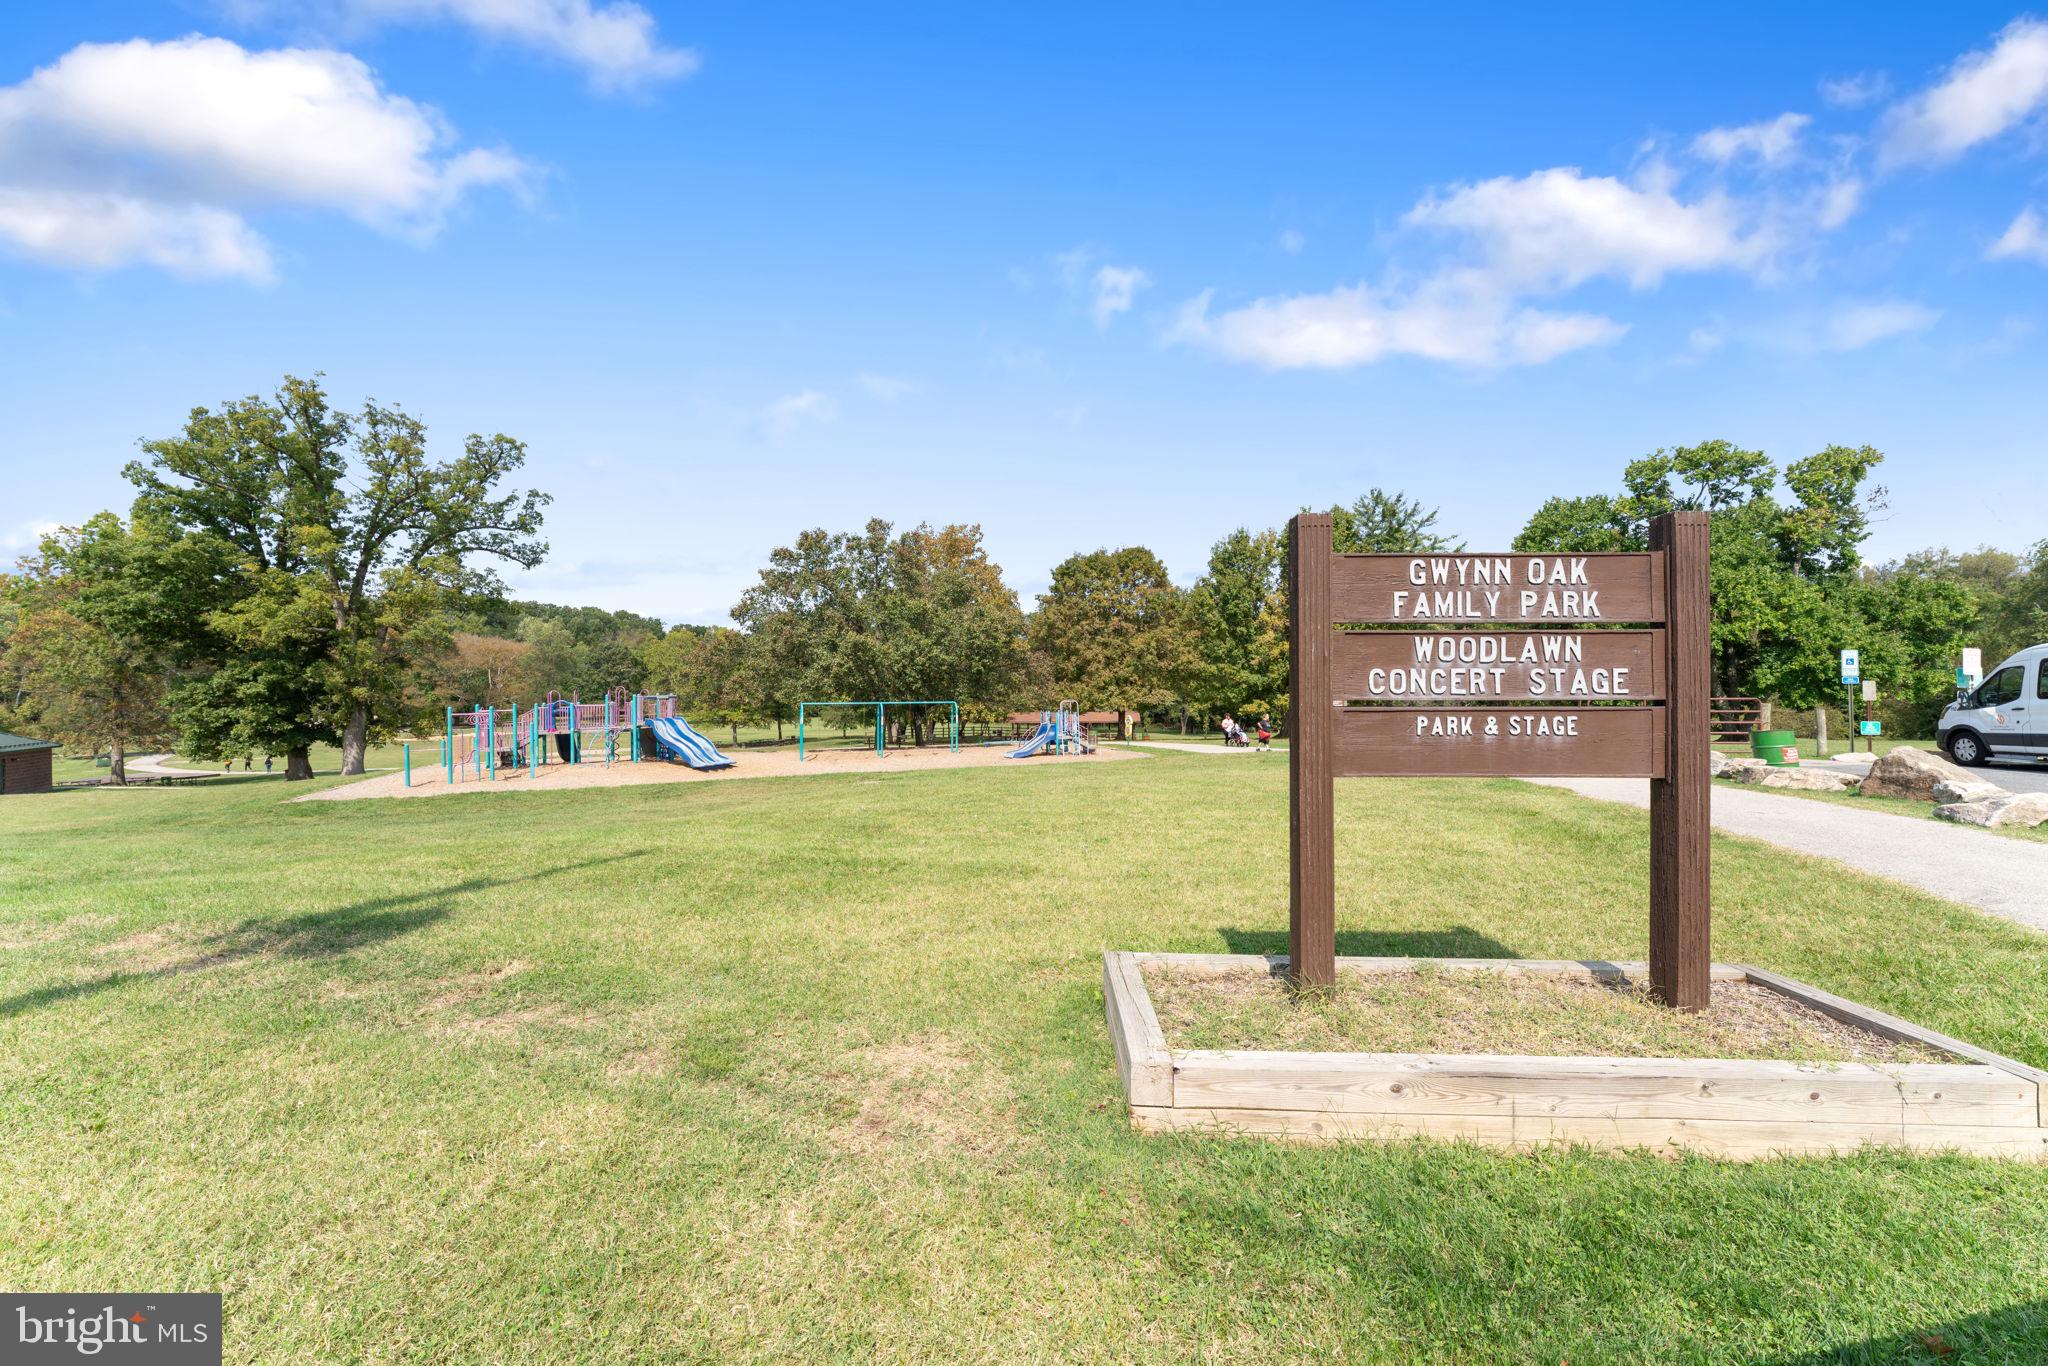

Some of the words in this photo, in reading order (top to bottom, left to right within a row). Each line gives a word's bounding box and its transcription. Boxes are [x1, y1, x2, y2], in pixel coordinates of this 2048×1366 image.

[1409, 557, 1512, 586] GWYNN
[1527, 557, 1588, 586] OAK
[1393, 590, 1501, 618] FAMILY
[1520, 590, 1601, 618] PARK
[1414, 635, 1583, 664] WOODLAWN
[1368, 667, 1506, 696] CONCERT
[1528, 667, 1630, 696] STAGE
[1416, 715, 1473, 737] PARK
[1484, 715, 1499, 737] &
[1508, 715, 1579, 737] STAGE
